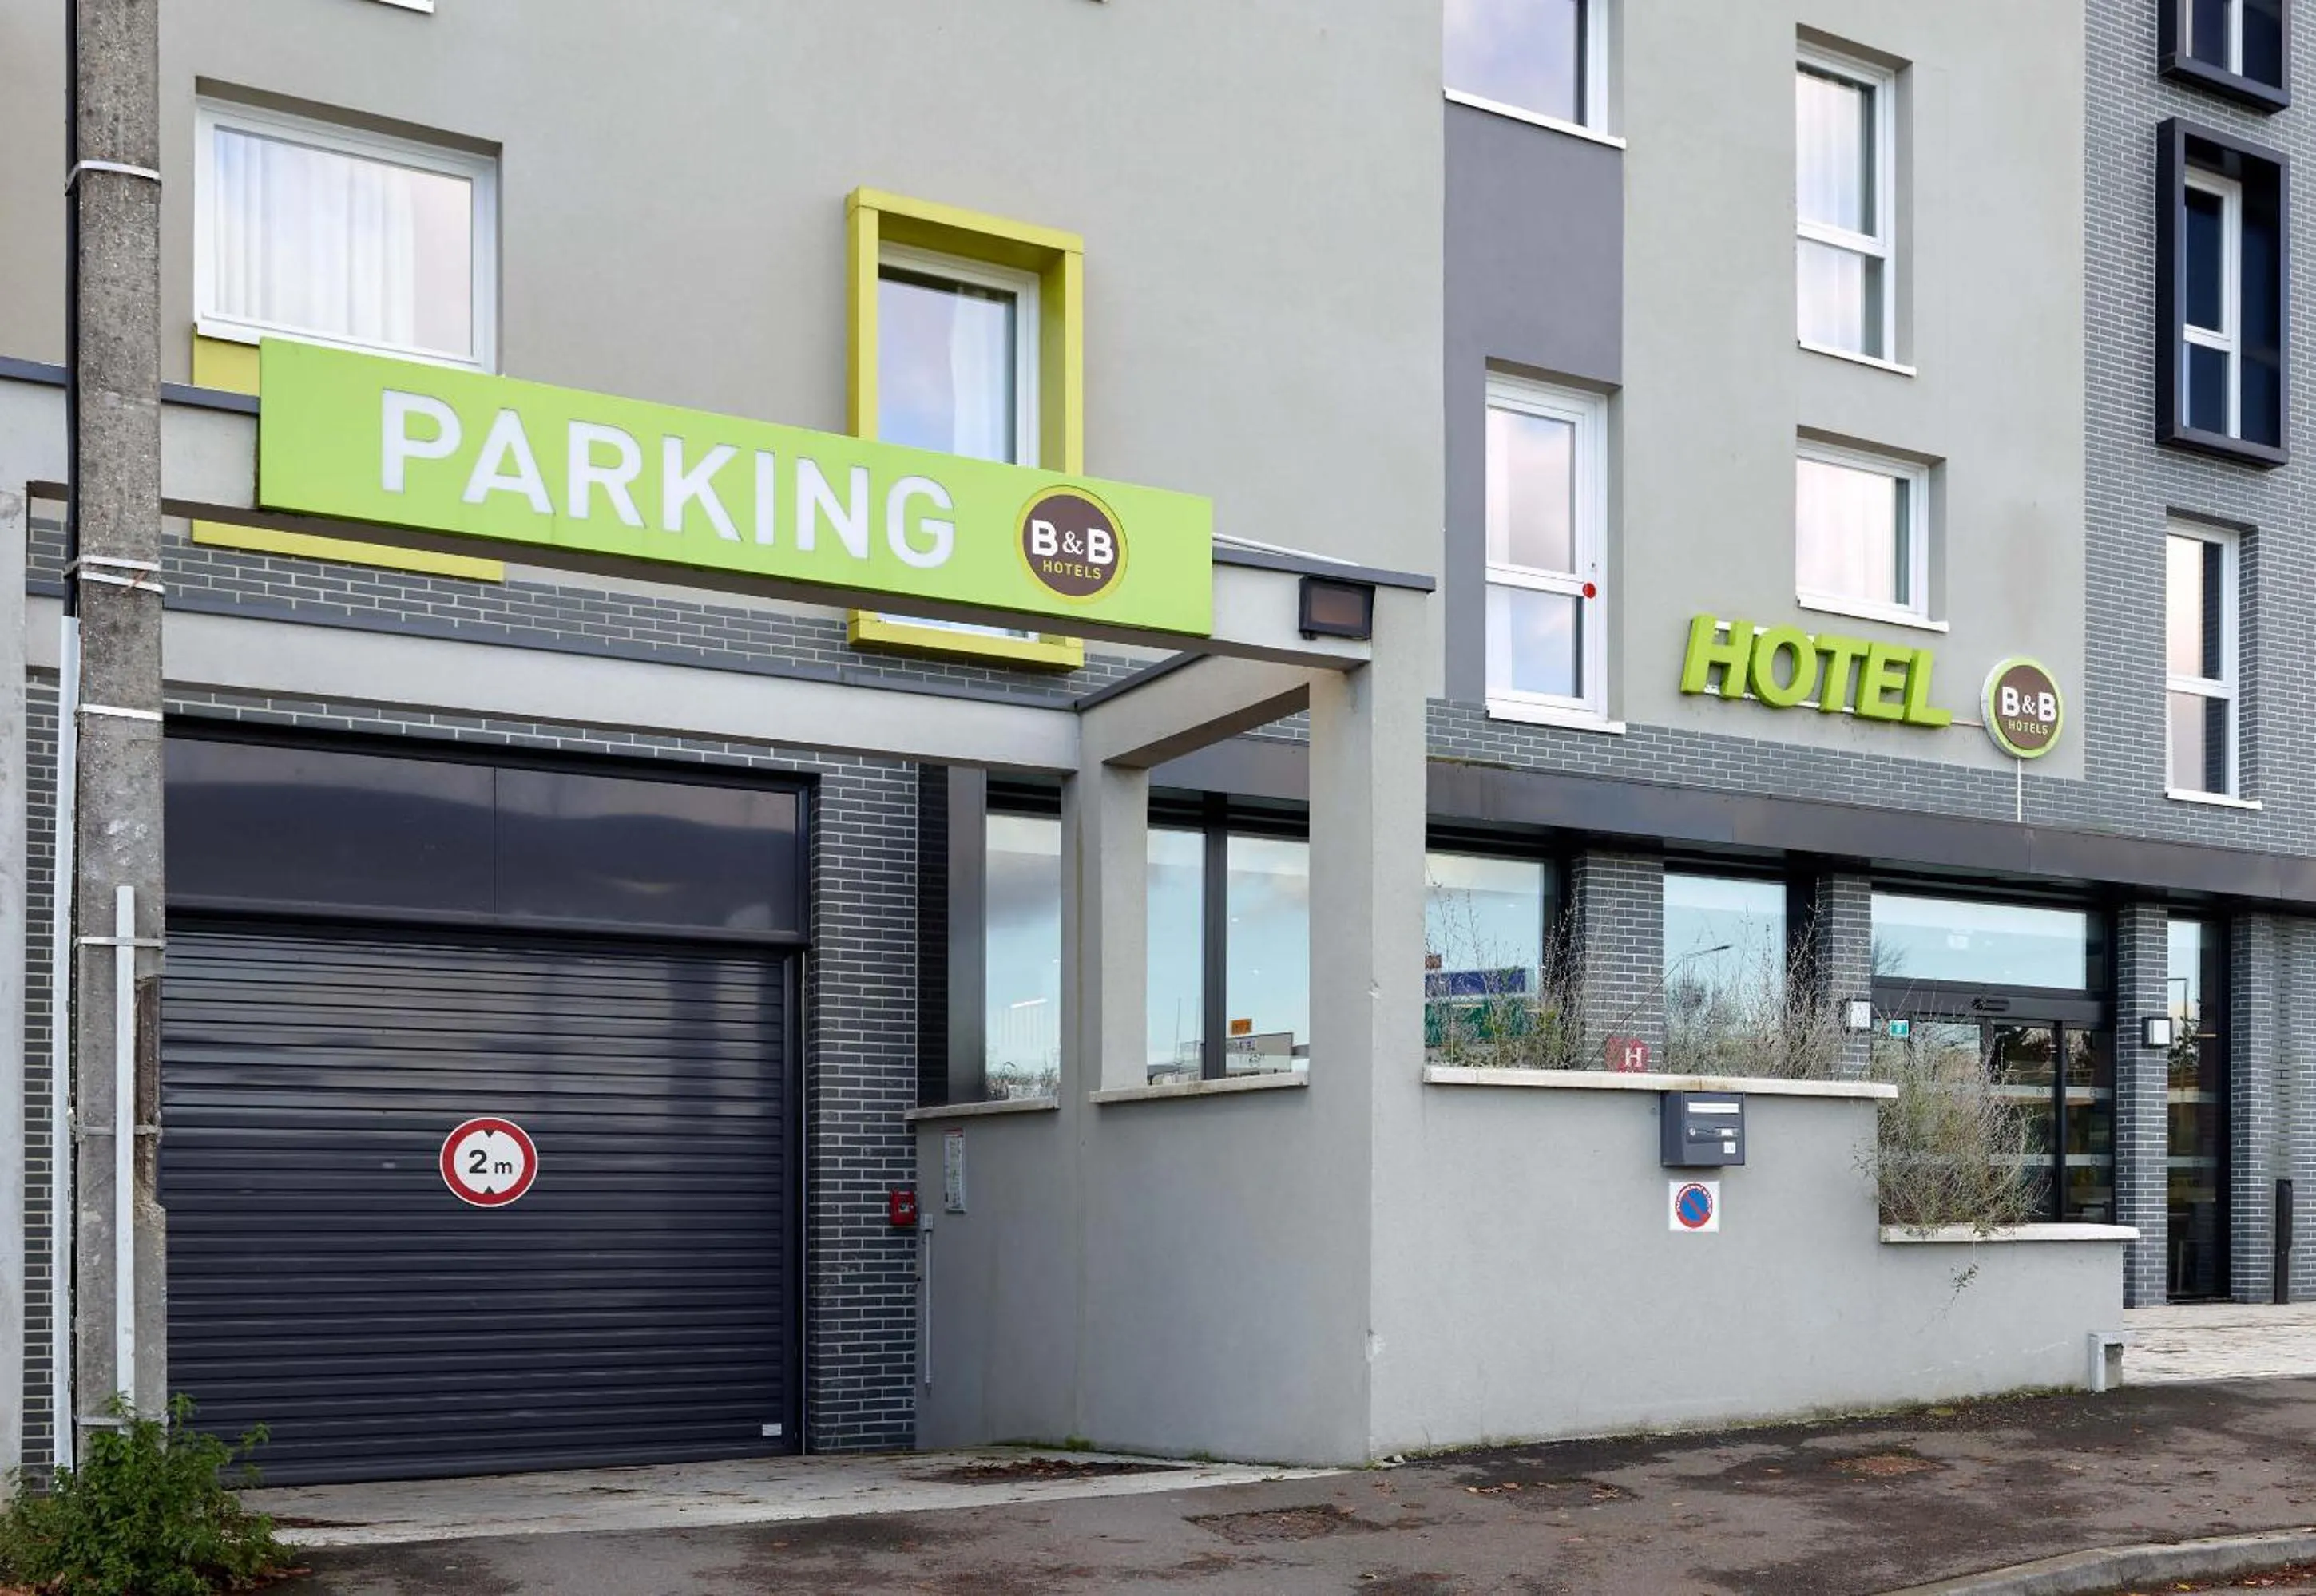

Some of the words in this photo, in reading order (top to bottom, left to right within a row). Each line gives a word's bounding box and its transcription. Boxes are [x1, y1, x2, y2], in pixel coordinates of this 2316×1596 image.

[382, 388, 955, 568] PARKING
[1031, 519, 1114, 564] B&B
[1042, 560, 1102, 580] HOTELS
[1681, 614, 1952, 727] HOTEL
[2001, 686, 2056, 722] B&B
[2008, 719, 2048, 735] HOTELS
[1625, 1047, 1643, 1067] H
